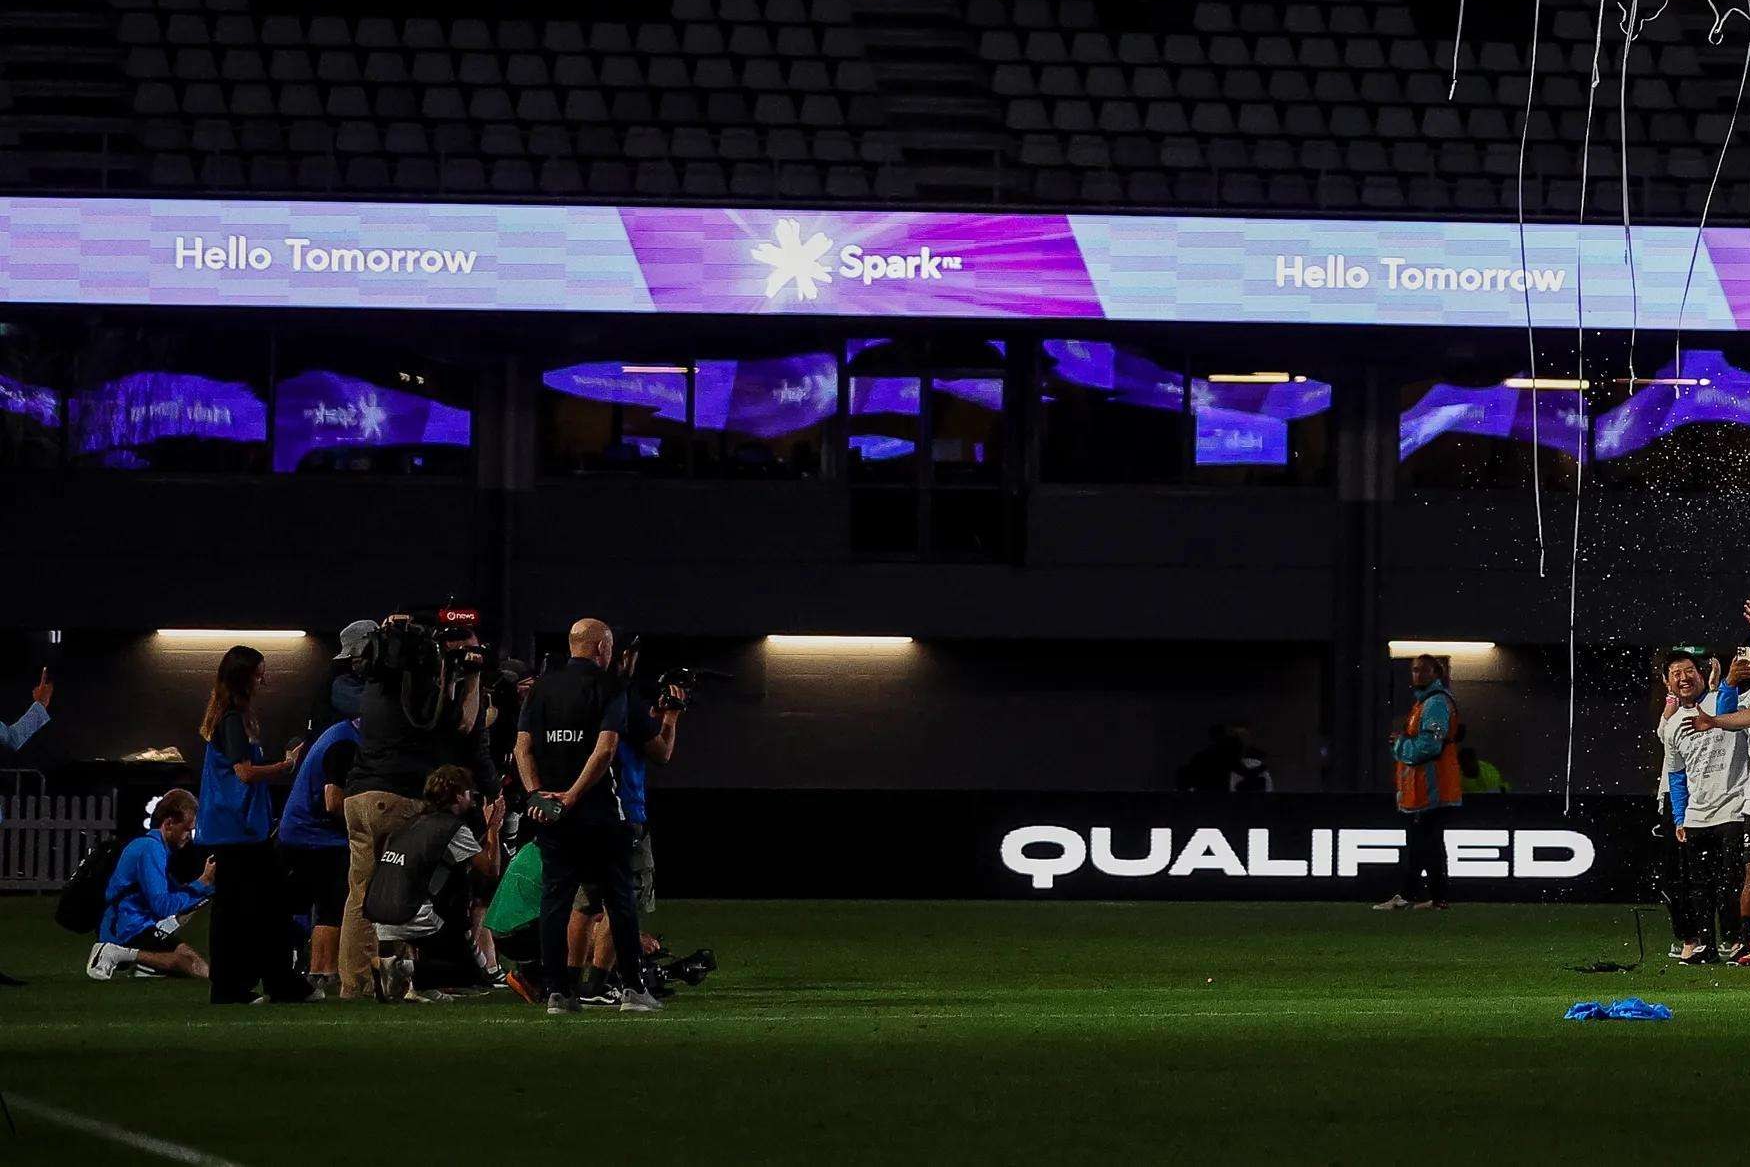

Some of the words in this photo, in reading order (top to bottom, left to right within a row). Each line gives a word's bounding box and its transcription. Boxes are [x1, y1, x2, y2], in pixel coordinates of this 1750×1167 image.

[175, 235, 272, 270] Hello
[284, 238, 478, 274] Tomorrow
[840, 244, 942, 285] Spark
[1275, 254, 1370, 289] Hello
[1380, 257, 1566, 292] Tomorrow
[546, 729, 584, 743] MEDIA
[381, 850, 406, 866] EDIA
[1001, 825, 1596, 888] QUALIFED
